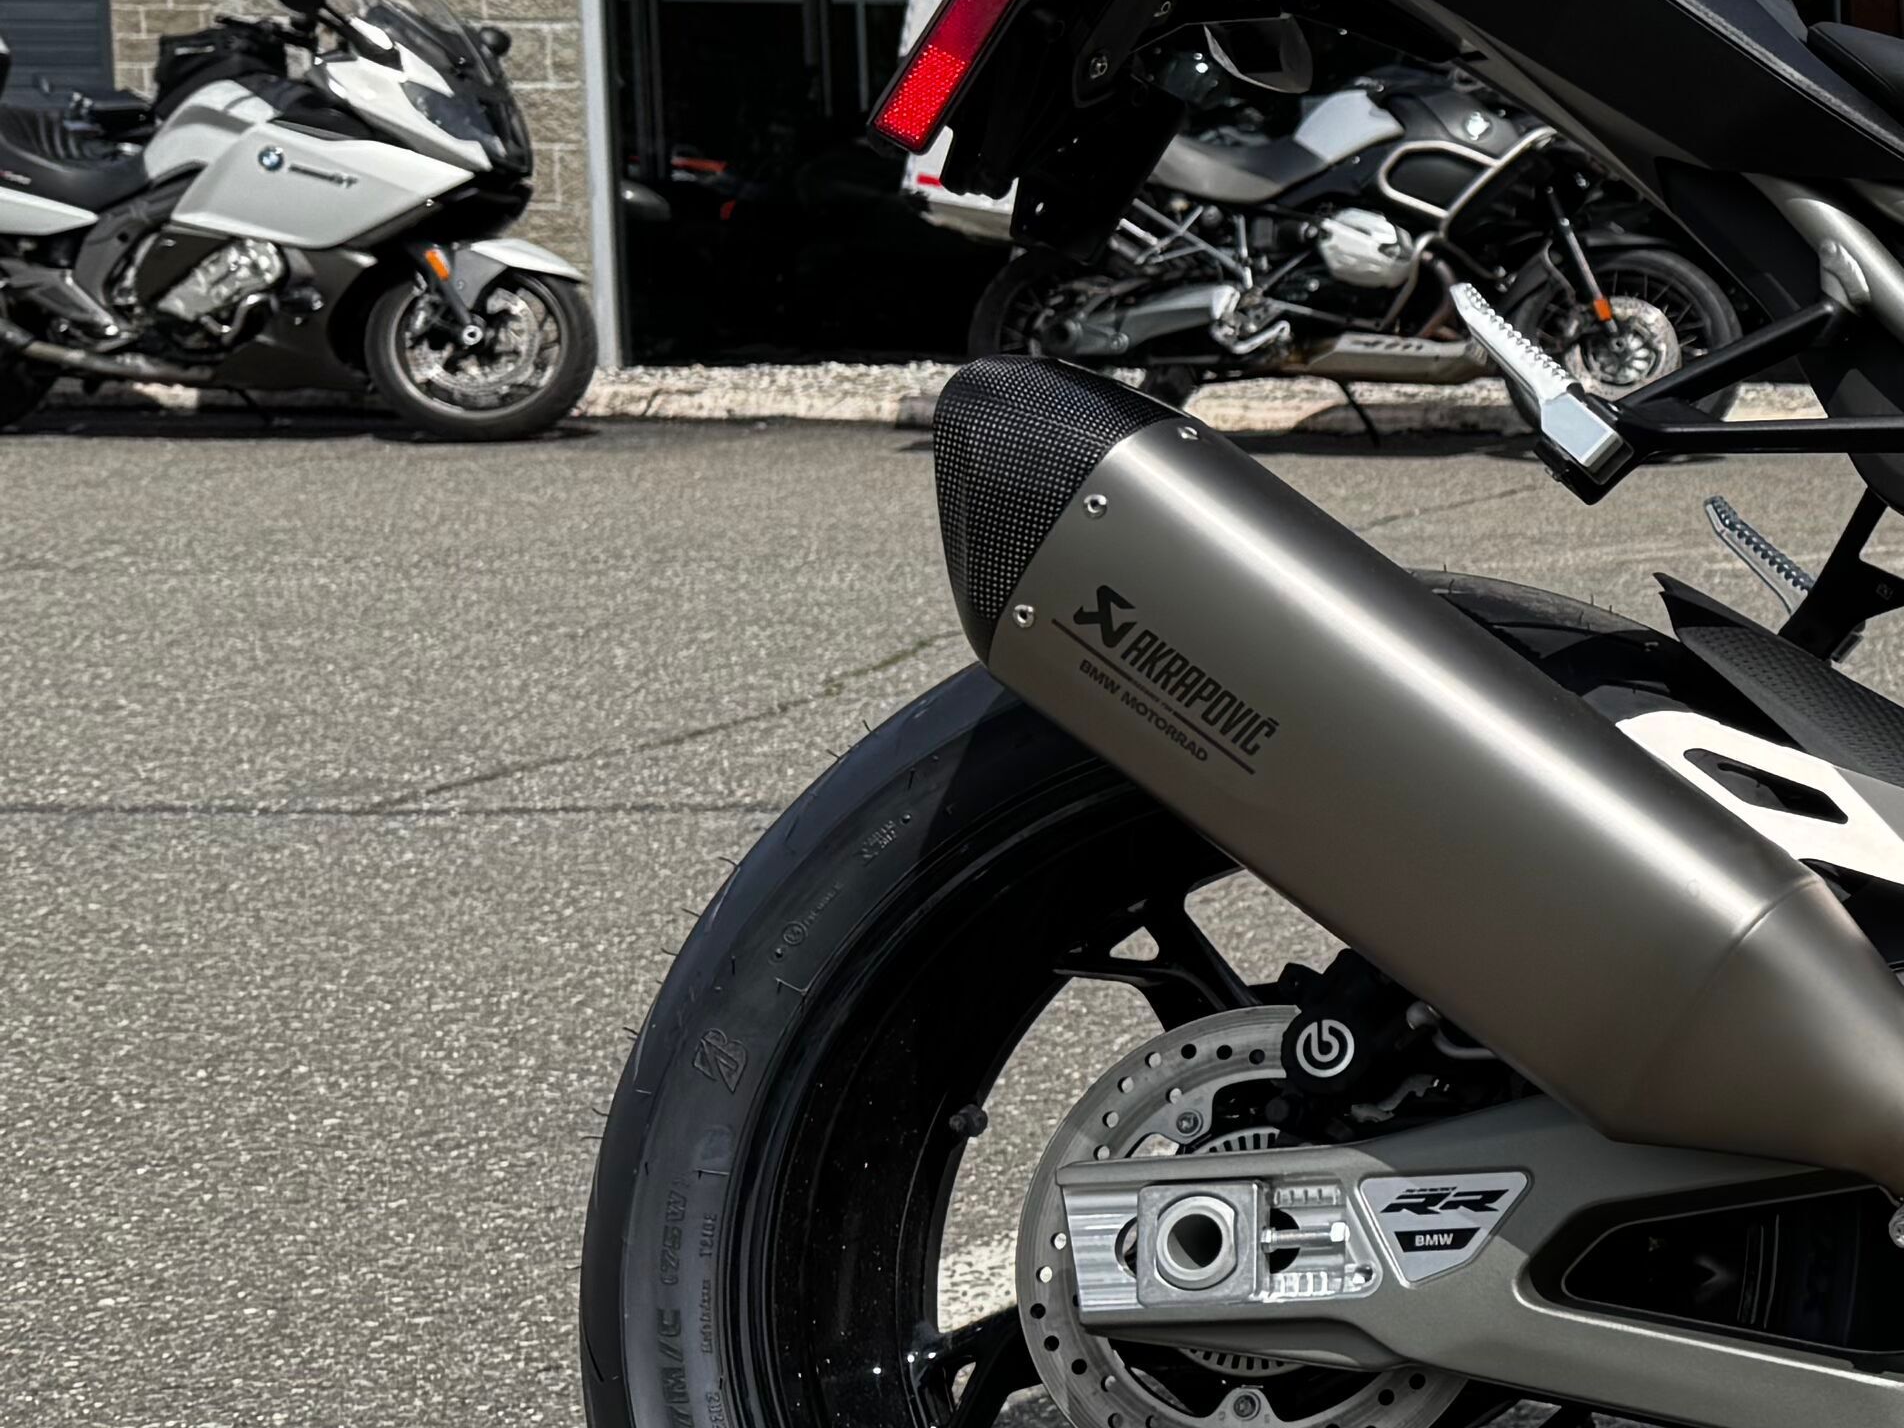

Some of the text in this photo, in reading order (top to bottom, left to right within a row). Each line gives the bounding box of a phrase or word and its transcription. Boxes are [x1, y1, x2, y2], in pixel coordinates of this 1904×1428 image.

[1079, 659, 1121, 701] BMW
[1121, 690, 1209, 763] MOTORRAD
[1129, 626, 1280, 758] AKRAPOVIČ
[1379, 1188, 1509, 1216] RR
[1415, 1233, 1454, 1247] BMW
